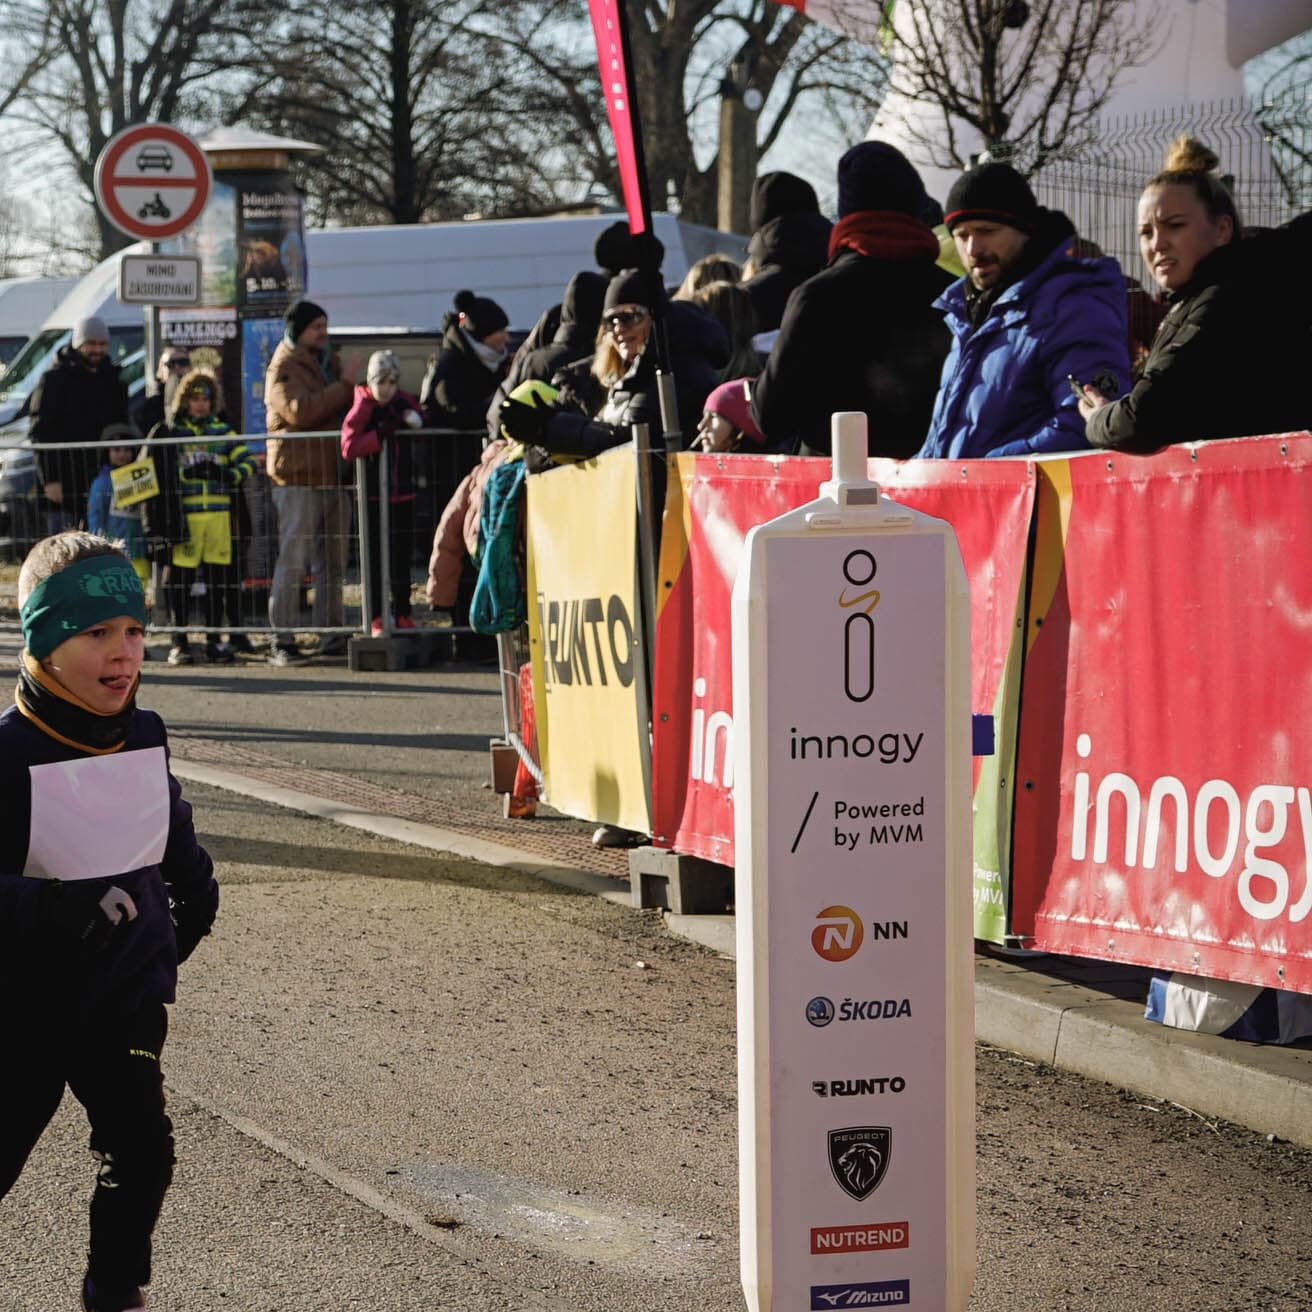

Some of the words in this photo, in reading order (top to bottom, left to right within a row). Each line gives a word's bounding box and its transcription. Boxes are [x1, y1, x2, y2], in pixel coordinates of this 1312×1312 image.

[791, 728, 924, 764] innogy
[834, 797, 925, 820] Powered
[834, 827, 860, 852] by
[869, 824, 924, 845] MVM
[874, 921, 908, 940] NN
[838, 997, 912, 1021] ŠKODA
[830, 1076, 906, 1097] RUNTO
[833, 1133, 886, 1143] PEUGEOT
[816, 1226, 905, 1249] NUTREND
